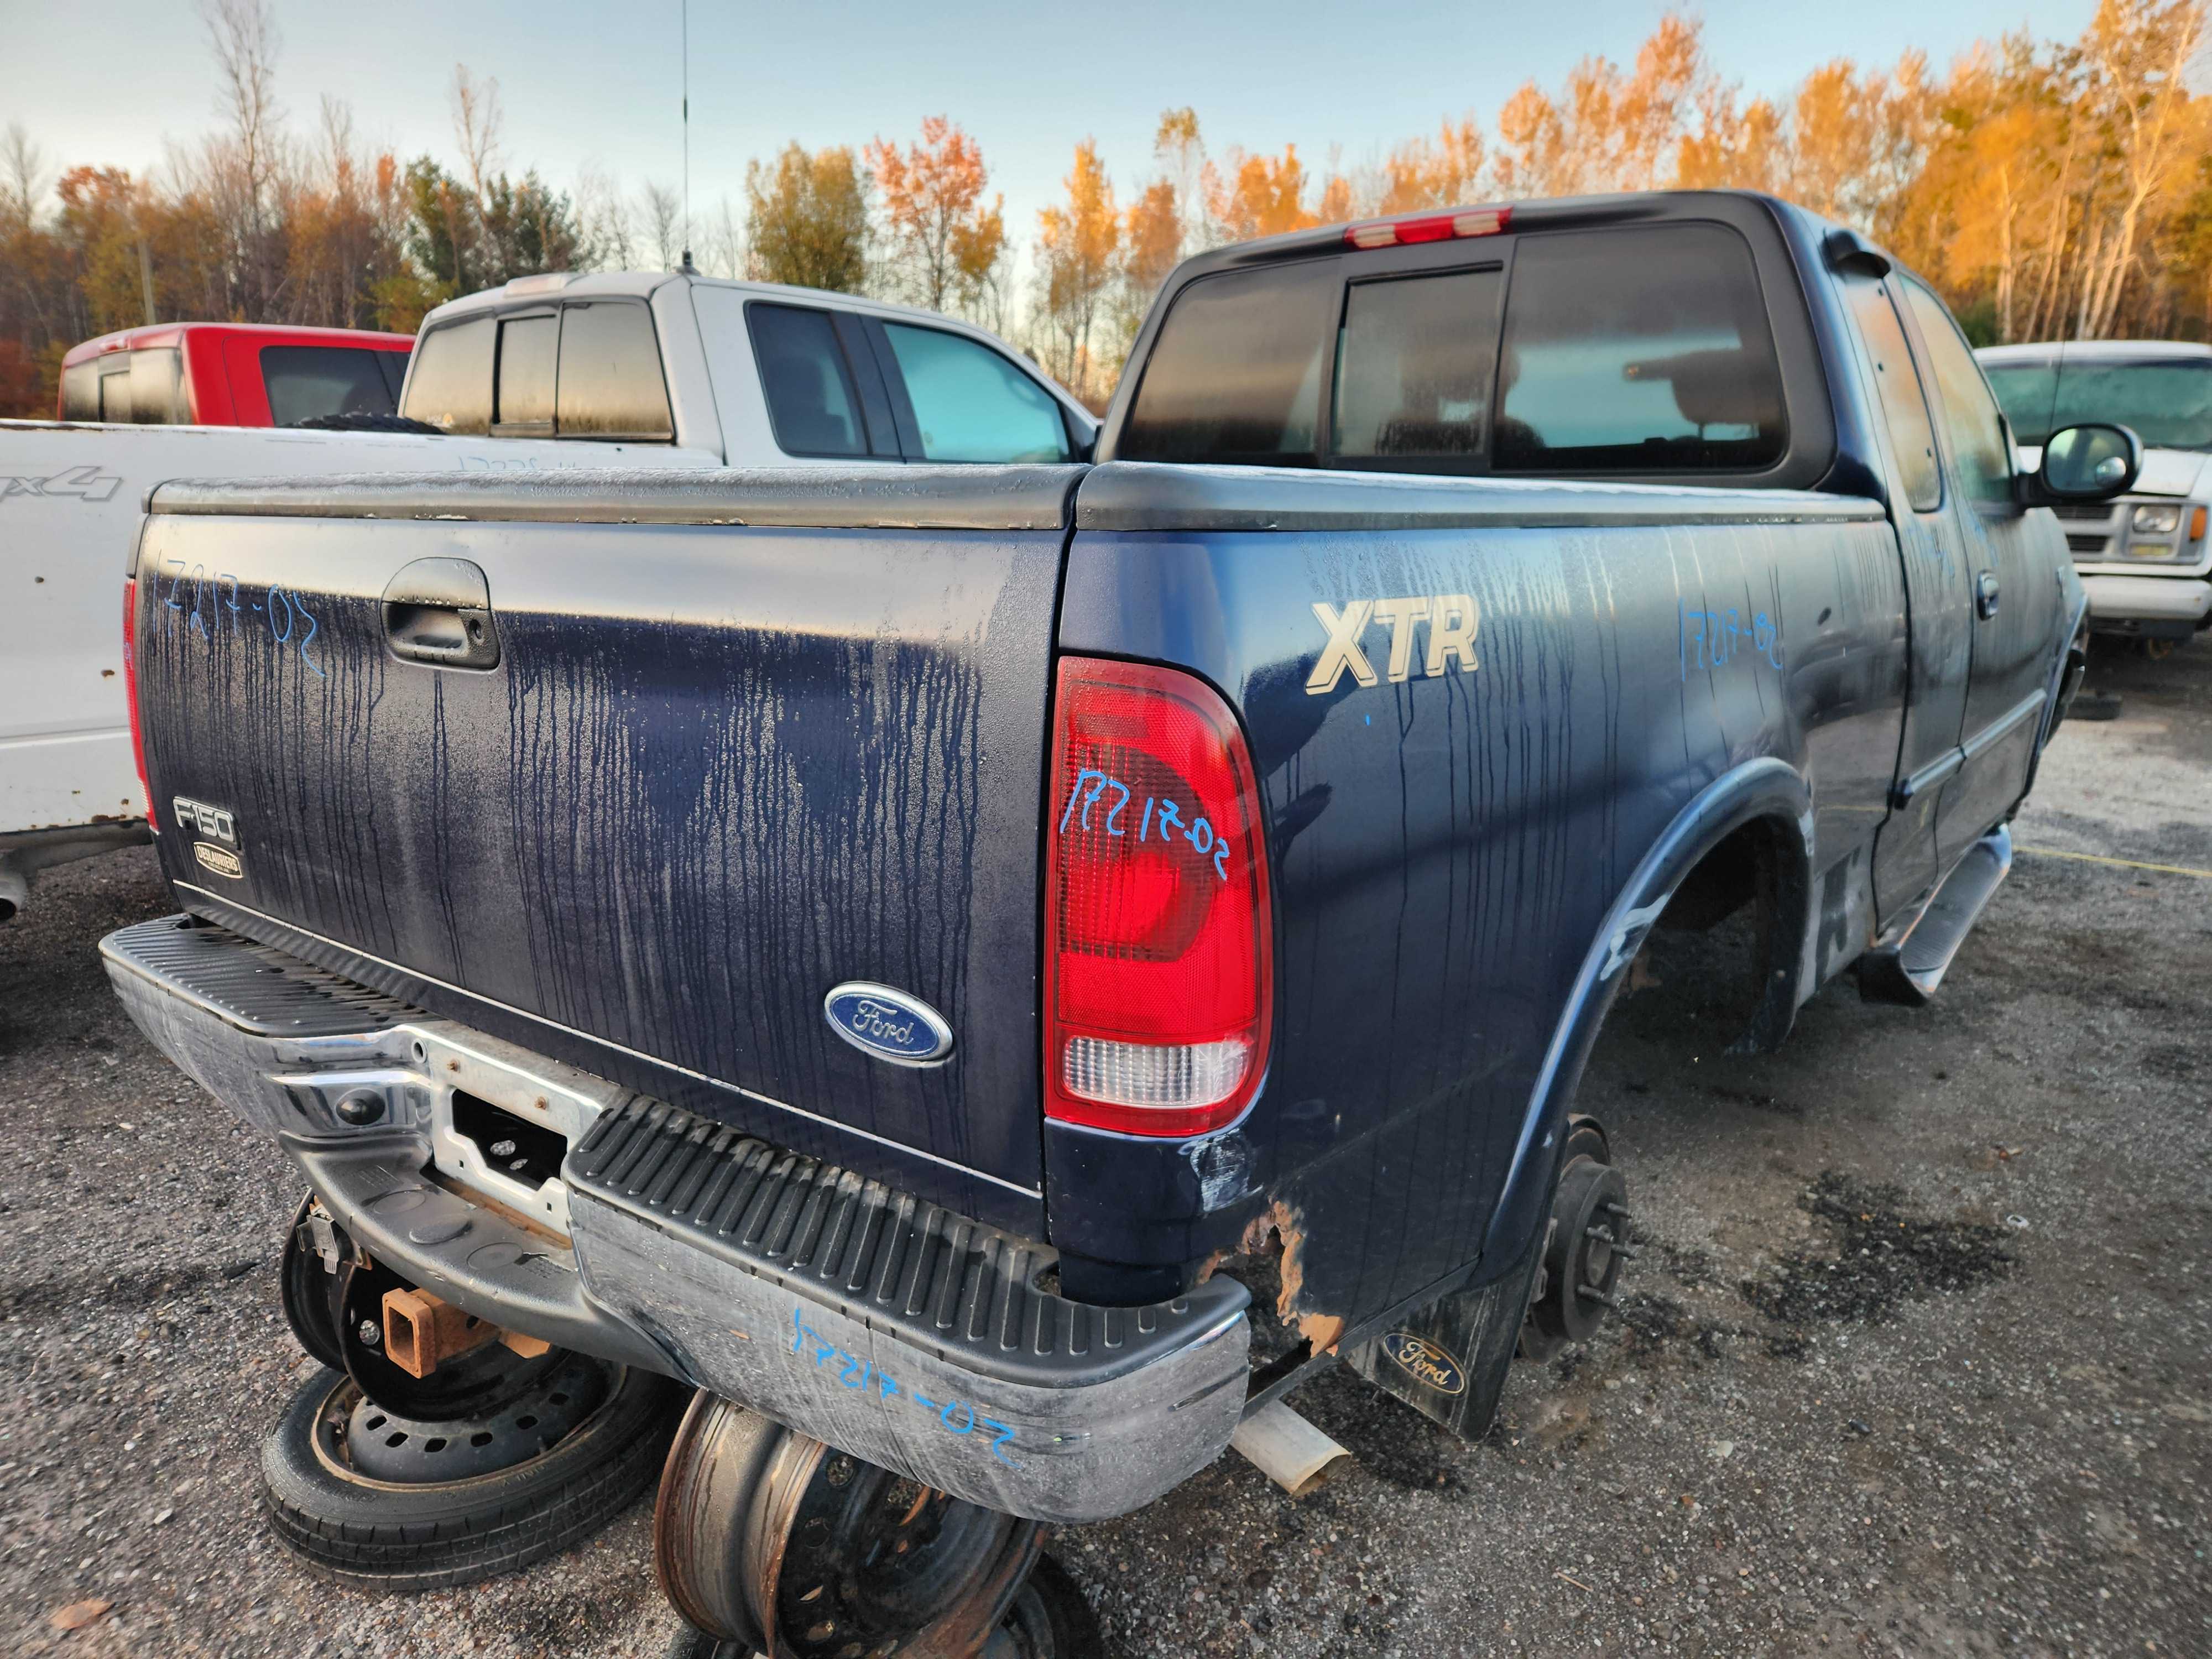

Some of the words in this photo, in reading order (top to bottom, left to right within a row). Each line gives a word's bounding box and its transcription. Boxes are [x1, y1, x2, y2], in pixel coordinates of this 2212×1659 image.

[1305, 593, 1480, 696] XTR
[853, 1000, 915, 1045] Ford
[1399, 1342, 1452, 1385] Ford
